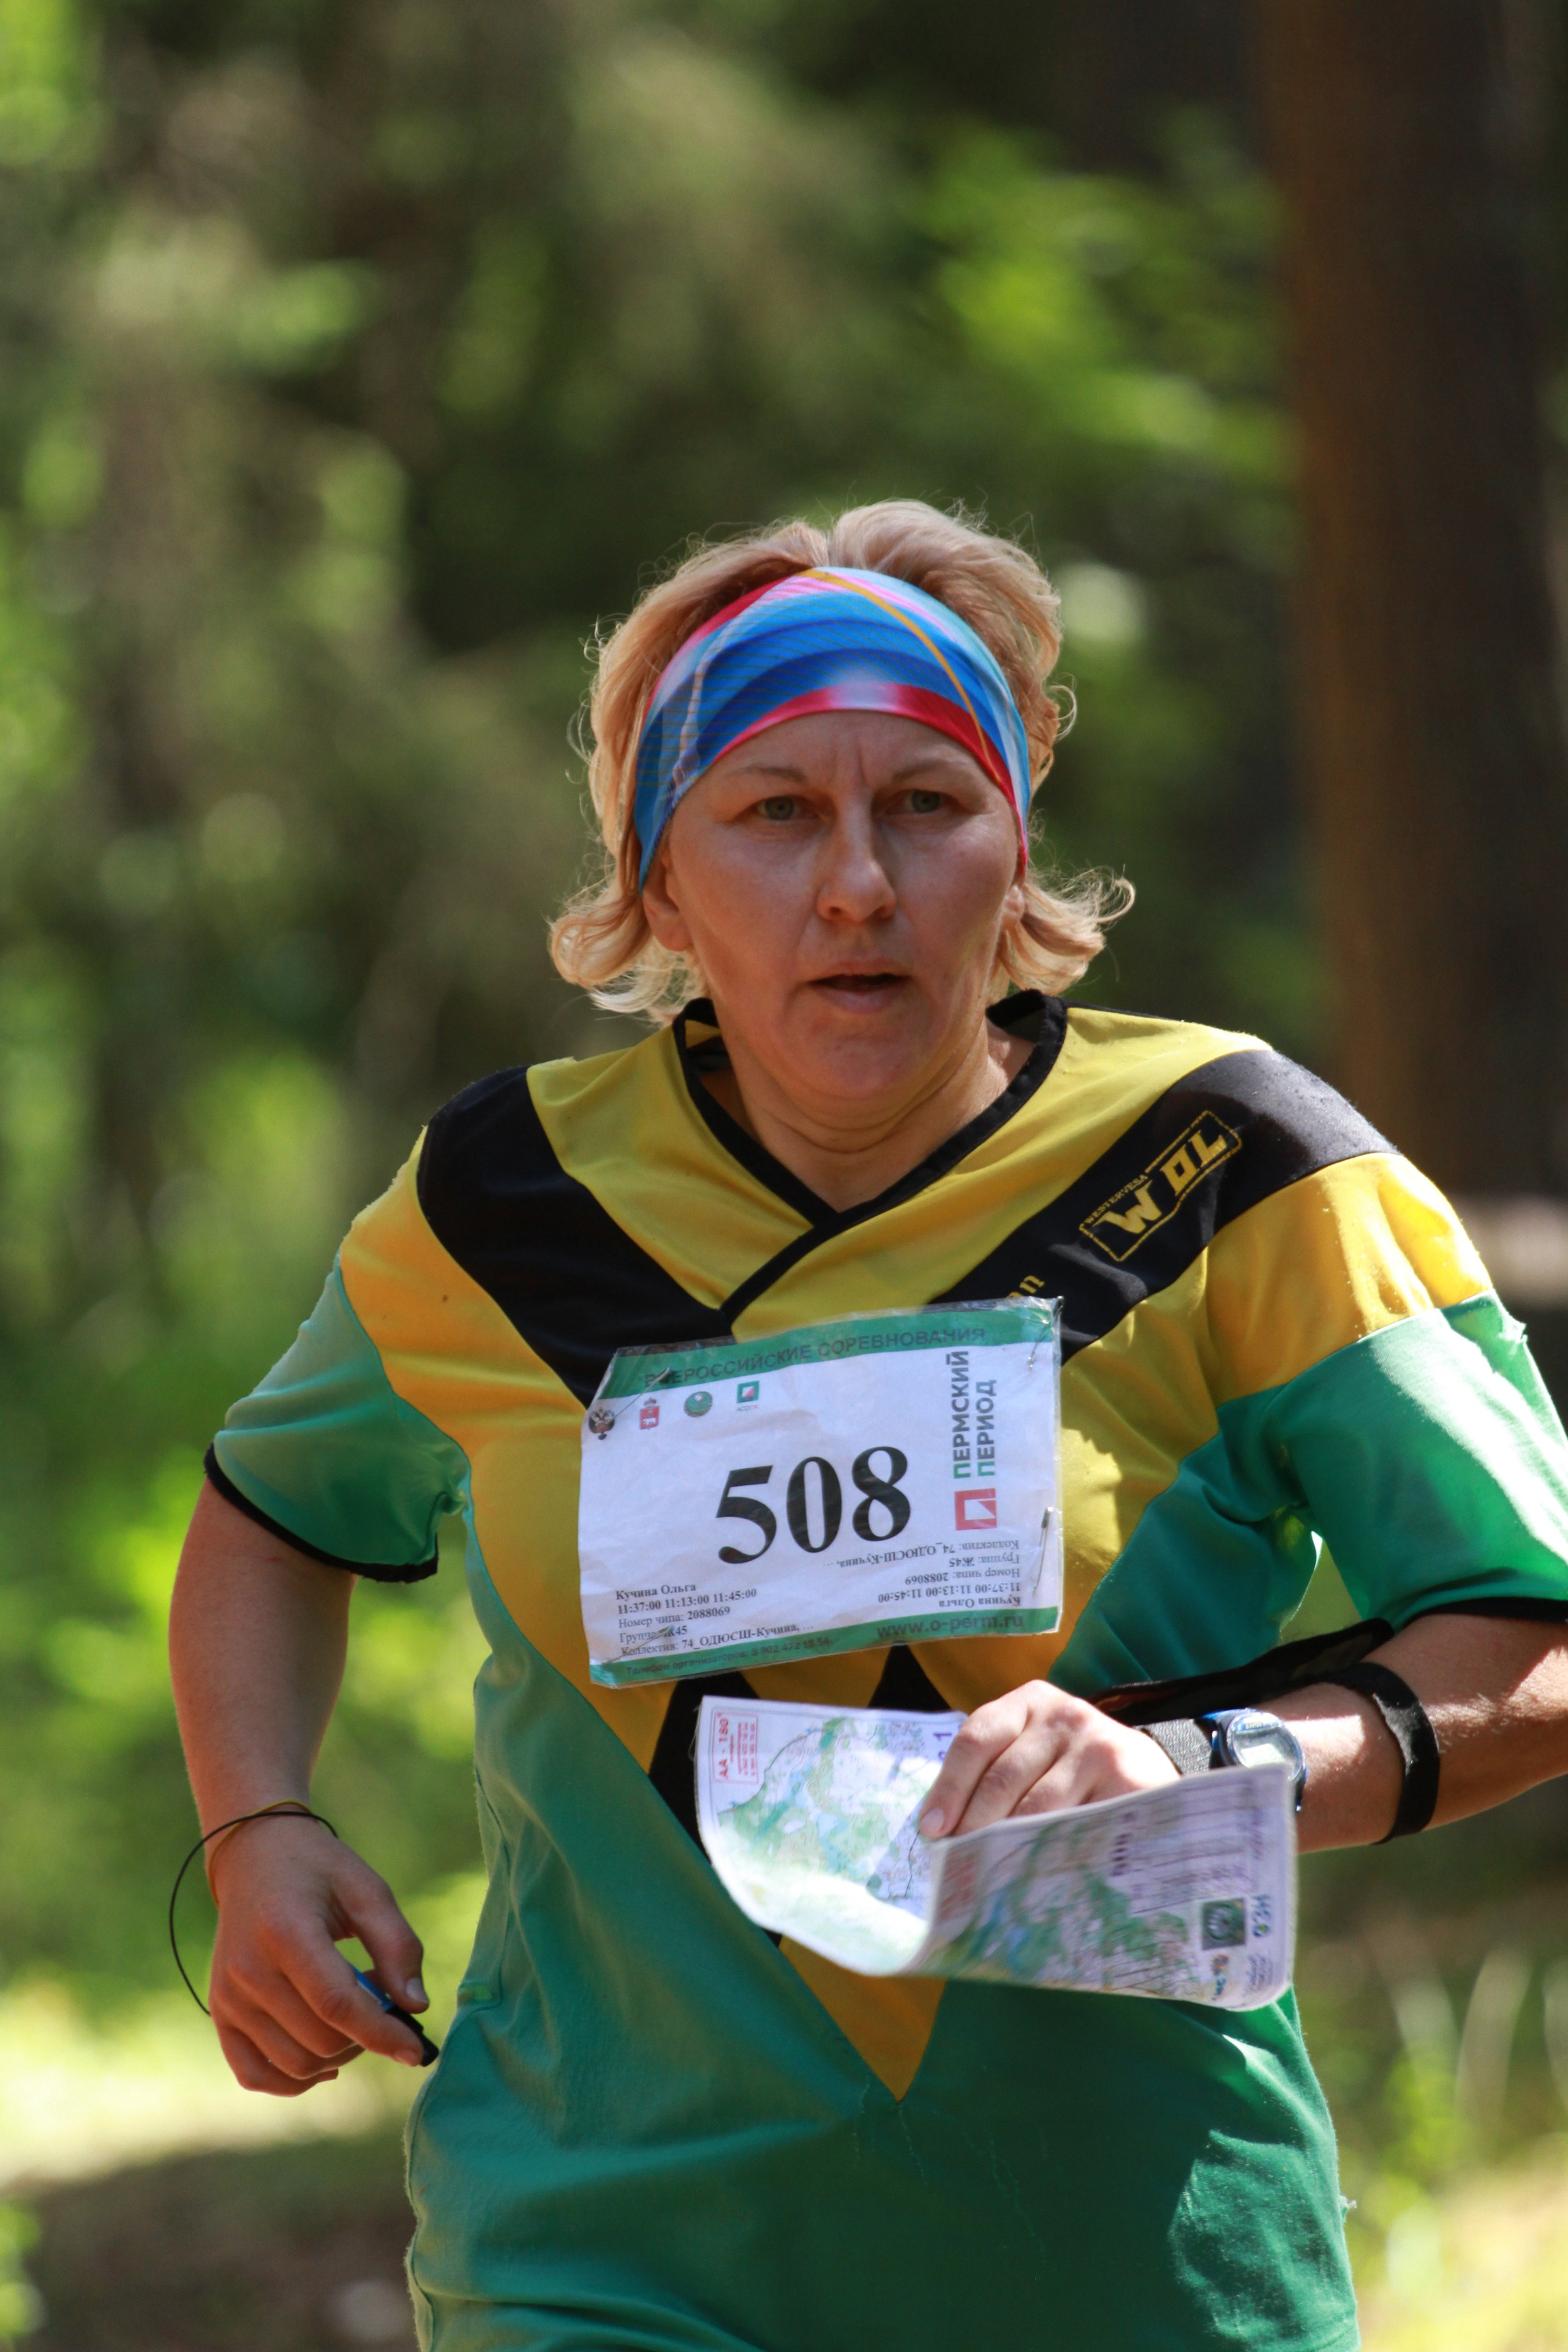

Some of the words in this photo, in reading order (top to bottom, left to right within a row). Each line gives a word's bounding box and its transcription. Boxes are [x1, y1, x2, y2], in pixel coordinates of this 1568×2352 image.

[645, 1344, 811, 1387] ВЕРОССИЙСКИЕ
[817, 1327, 986, 1358] СОРЕВНОВАНИЯ
[946, 1351, 971, 1479] ПЕРМСКИЙ
[976, 1379, 997, 1477] ПЕРИОД
[715, 1446, 911, 1564] 508
[960, 1539, 1019, 1550] Коллектив:
[949, 1557, 975, 1568] Ж45
[978, 1552, 1020, 1564] Группа:
[905, 1572, 949, 1585] 2088069
[952, 1570, 982, 1578] чипа:
[985, 1567, 1020, 1579] Номер
[616, 1588, 657, 1602] Кучина
[660, 1584, 696, 1594] Ольга
[925, 1585, 971, 1597] 11:13:00
[974, 1582, 1021, 1594] 11:37:00
[617, 1600, 662, 1615] 11:37:00
[665, 1595, 709, 1608] 11:13:00
[713, 1588, 757, 1603] 11:45:00
[878, 1589, 922, 1603] 11:45:00
[978, 1595, 1021, 1608] Кучина
[938, 1598, 975, 1608] Ольга
[619, 1617, 653, 1629] Номер
[655, 1613, 684, 1624] чипа:
[687, 1606, 731, 1621] 2088069
[876, 1612, 1024, 1639] www.o-perm.ru
[626, 1664, 670, 1675] Телефон
